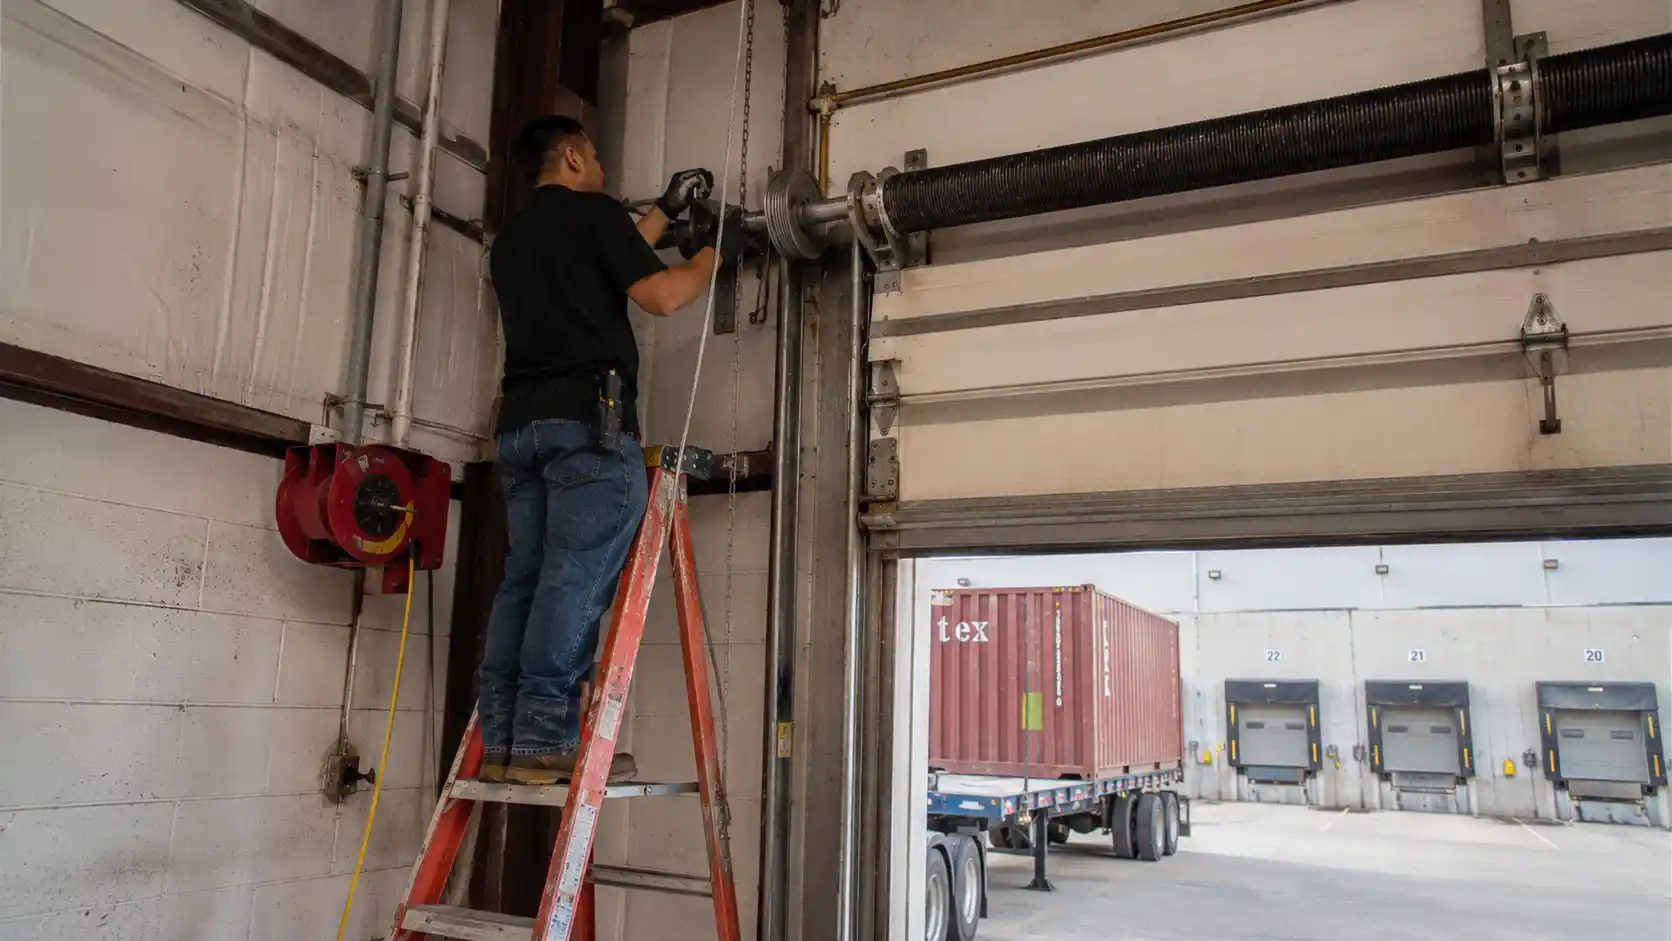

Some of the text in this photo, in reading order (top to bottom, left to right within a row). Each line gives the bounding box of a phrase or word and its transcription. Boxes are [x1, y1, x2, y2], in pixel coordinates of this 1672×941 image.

[937, 615, 989, 642] tex
[1267, 650, 1281, 661] 22
[1410, 650, 1424, 661] 21
[1586, 650, 1603, 662] 20
